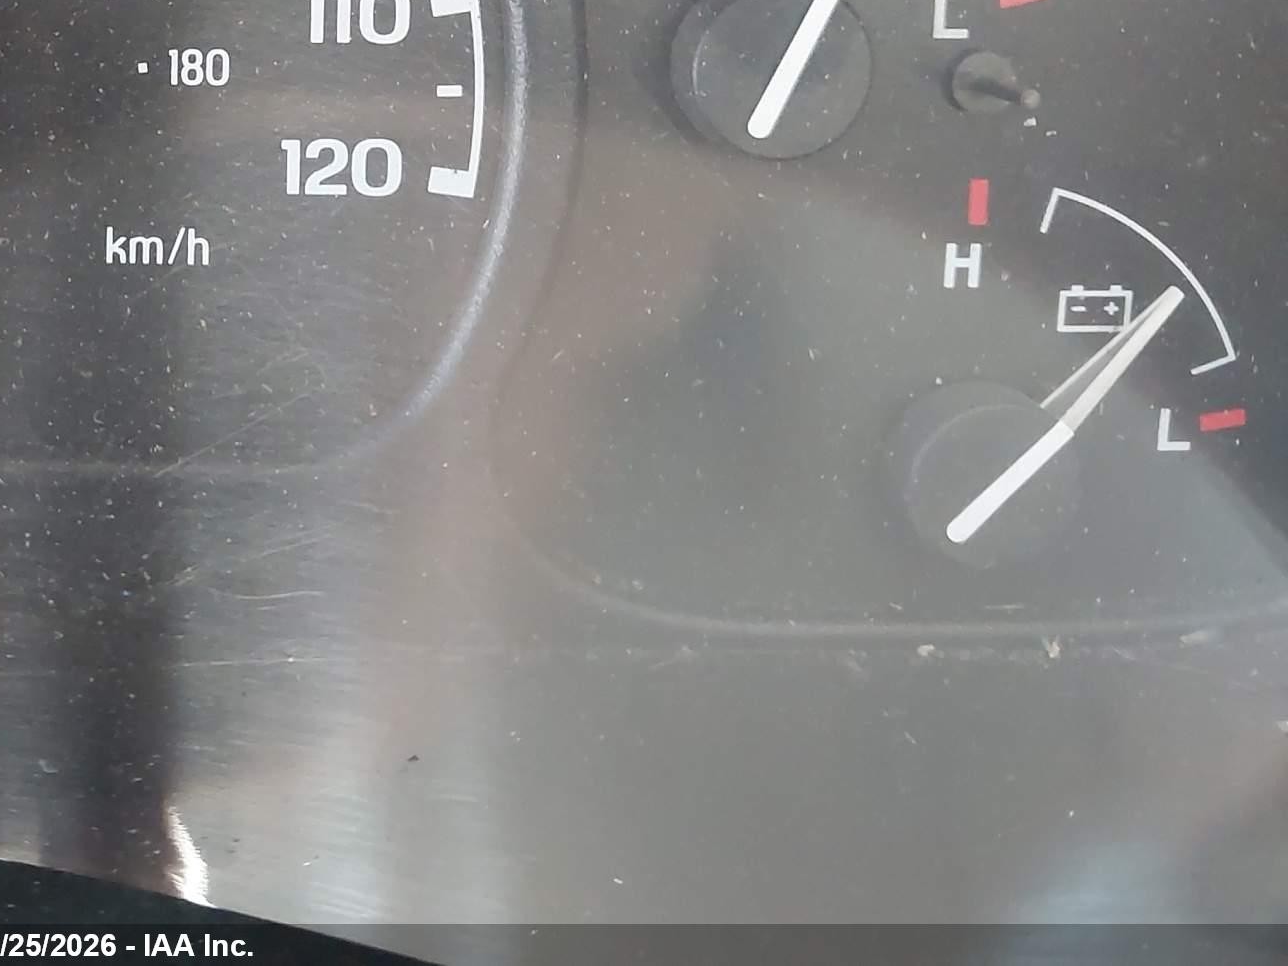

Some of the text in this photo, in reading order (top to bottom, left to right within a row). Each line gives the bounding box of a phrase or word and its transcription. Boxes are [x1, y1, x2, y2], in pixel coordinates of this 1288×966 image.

[169, 49, 230, 86] 180
[281, 139, 402, 196] 120
[106, 227, 210, 265] km/h
[944, 243, 981, 287] H
[1158, 409, 1190, 450] L
